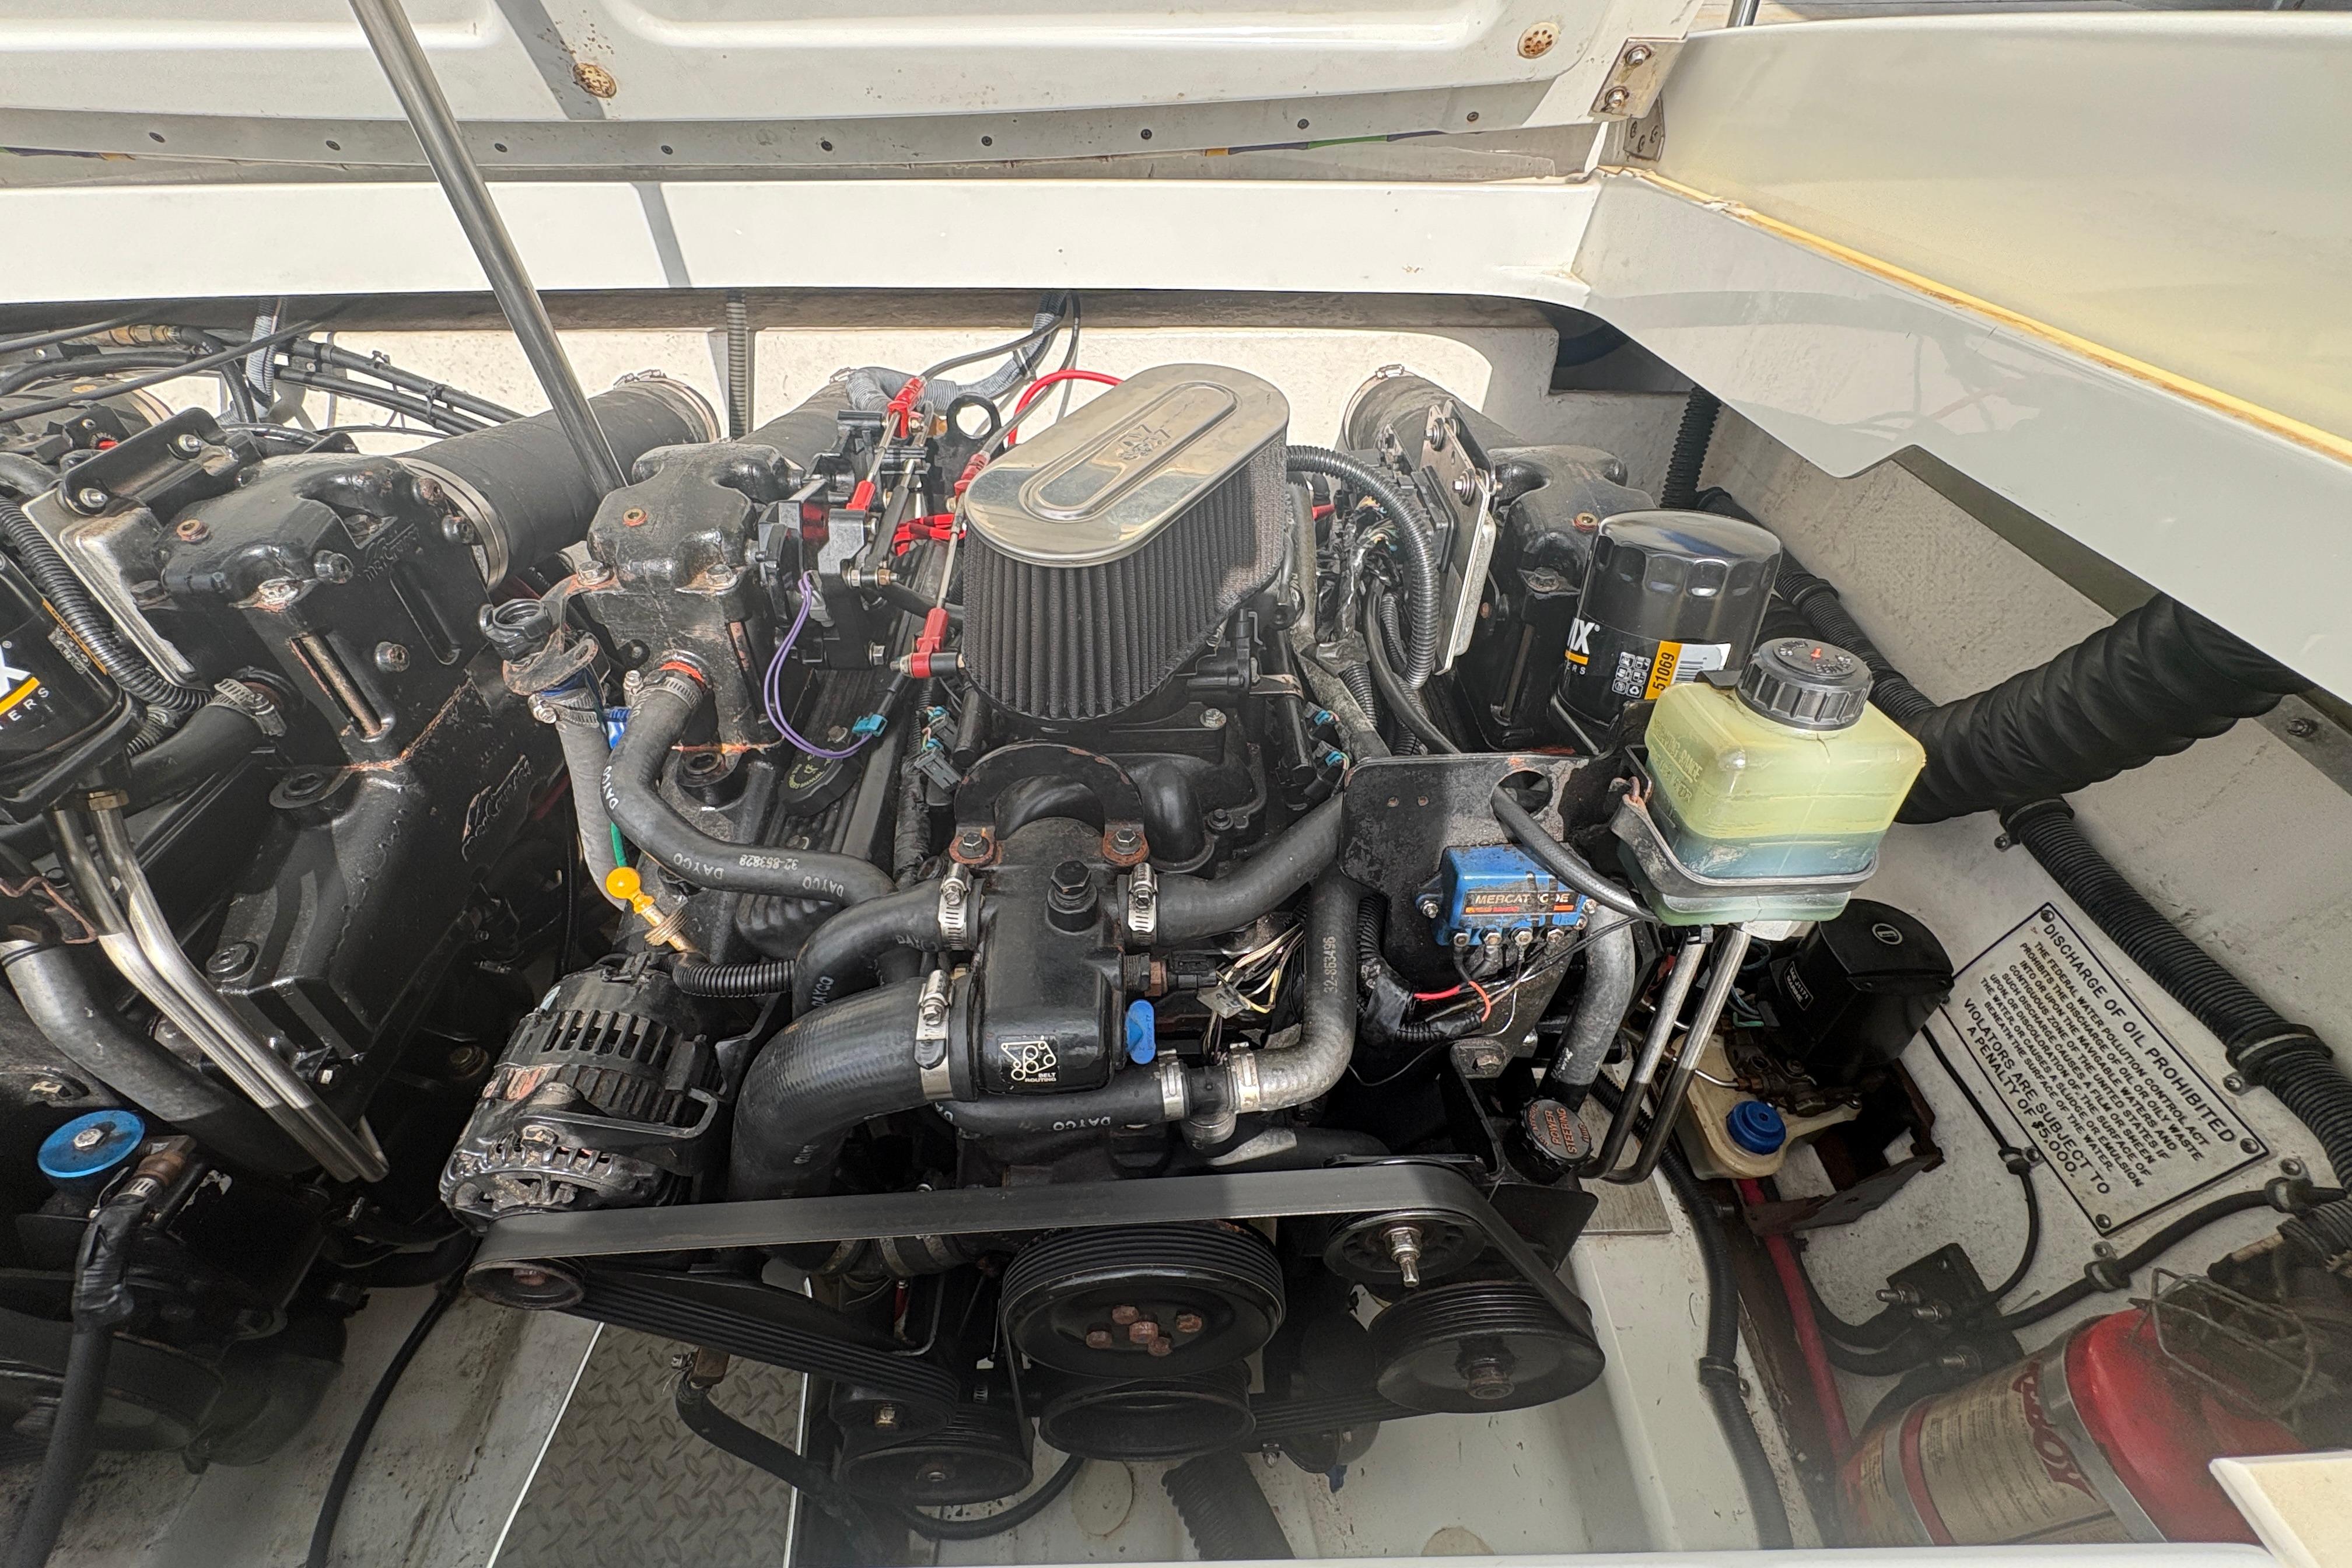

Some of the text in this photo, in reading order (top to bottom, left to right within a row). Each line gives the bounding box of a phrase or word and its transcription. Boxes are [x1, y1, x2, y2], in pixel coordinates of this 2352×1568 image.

[1653, 652, 1675, 691] 51069
[601, 765, 620, 810] DAYCO
[673, 852, 725, 880] DAYCO
[802, 876, 845, 898] DAYCO
[811, 975, 835, 1007] DAYCO
[1786, 975, 1804, 1003] MARINE
[2034, 941, 2210, 1145] THE FEDERAL WATER POLLUTION CONTROL ACT
[2043, 923, 2236, 1142] DISCHARGE OF OIL PROHIBITED
[1964, 997, 2110, 1194] VIOLATORS ARE SUBJECT TO
[1966, 1026, 1976, 1037] A
[1973, 1036, 2020, 1095] PENALTY
[2017, 1098, 2037, 1116] OF
[1980, 977, 1995, 996] THE
[2013, 1025, 2025, 1038] OR
[2023, 1038, 2052, 1073] CAUSES
[2055, 1082, 2088, 1120] SLUDGE
[2085, 1120, 2101, 1135] OR
[2097, 1135, 2144, 1188] EMULSION
[1983, 1000, 2014, 1040] BENEATH
[2011, 1038, 2027, 1058] THE
[2024, 1058, 2058, 1100] SURFACE
[2055, 1100, 2070, 1112] OF
[2066, 1112, 2085, 1134] THE
[2001, 972, 2157, 1164] SUCH DISCHARGE CAUSES A FILM OR SHEEN
[2007, 998, 2018, 1011] OR
[2015, 1010, 2070, 1078] DISCOLORATION
[2080, 1093, 2099, 1115] THE
[2096, 1115, 2138, 1161] SURFACE
[2134, 1162, 2152, 1176] OF
[2008, 964, 2171, 1159] CONTIGUOUS ZONE OF THE UNITED STATES IF
[2019, 942, 2205, 1162] PROHIBITS THE DISCHARGE OF OIL OR OILY WASTE
[2019, 960, 2177, 1150] INTO OR UPON THE NAVIGABLE WATERS AND
[1052, 1116, 1111, 1131] DAYCO
[1544, 1110, 1562, 1146] POWER
[1556, 1106, 1578, 1154] STEERING
